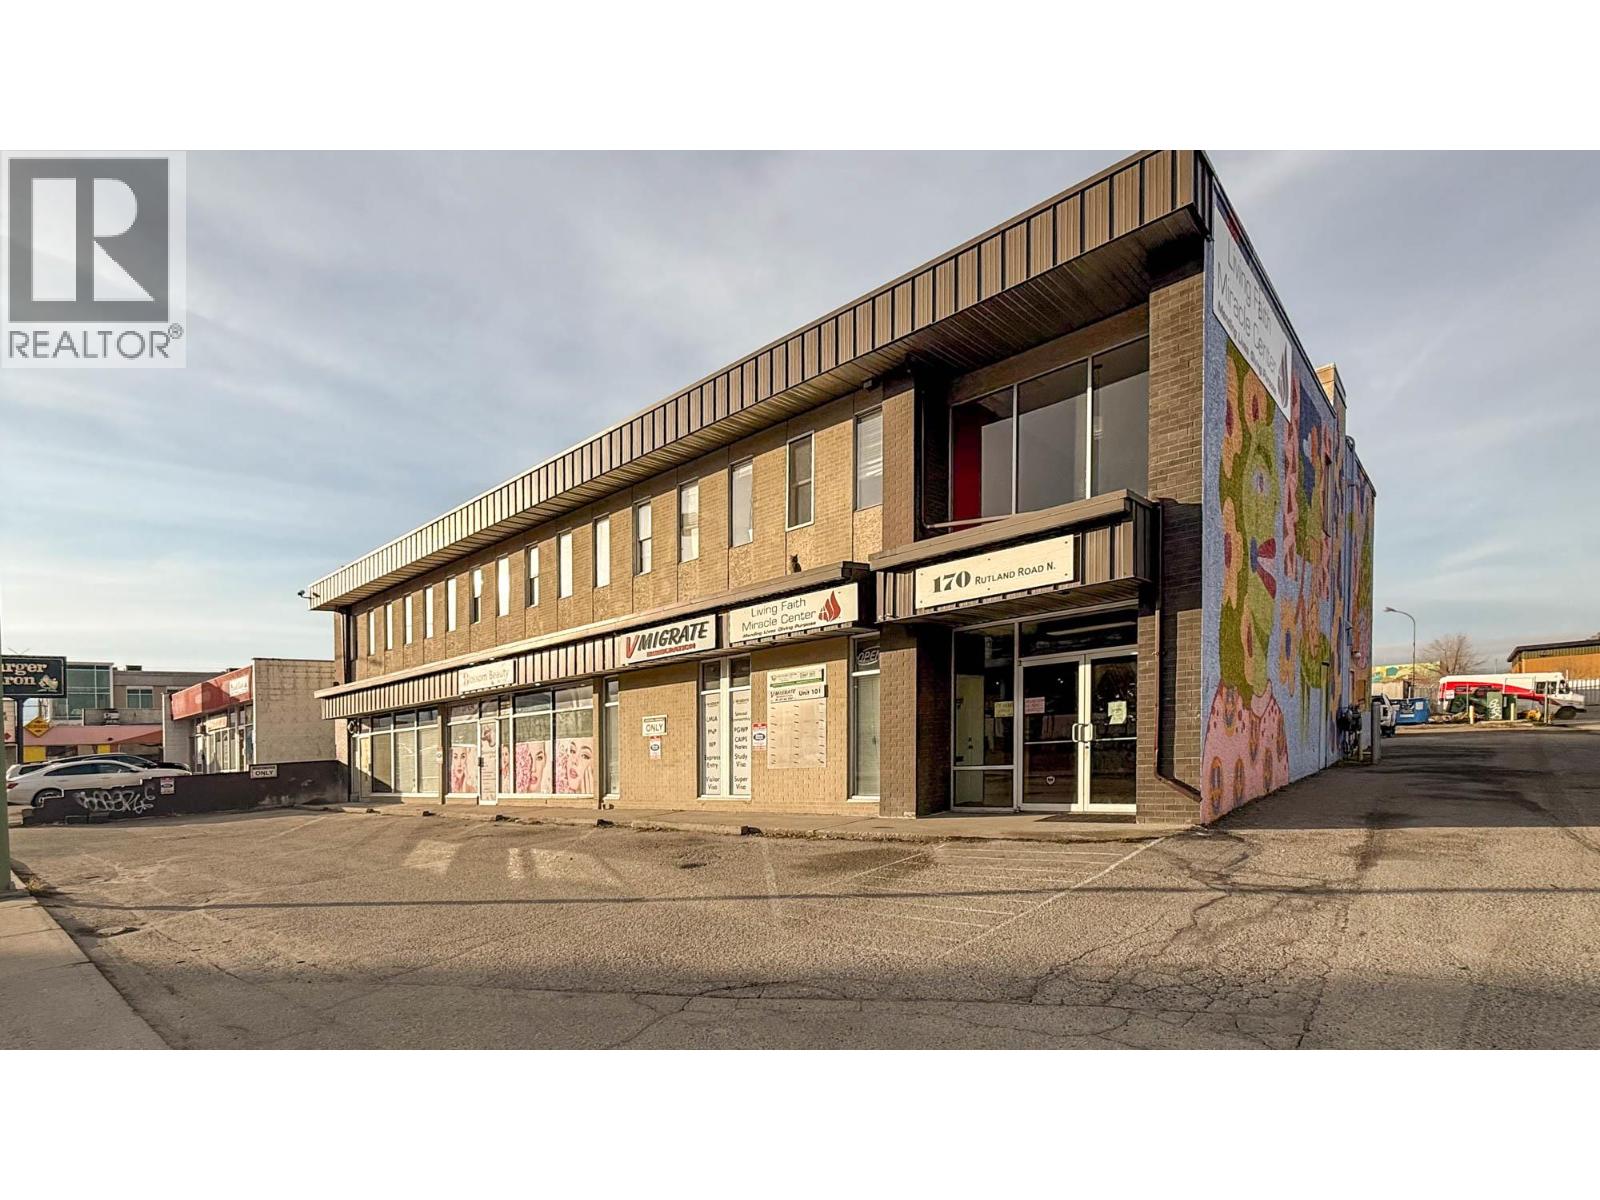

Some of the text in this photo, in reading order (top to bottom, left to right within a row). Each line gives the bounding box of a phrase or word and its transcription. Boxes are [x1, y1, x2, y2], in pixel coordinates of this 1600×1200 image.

[1228, 239, 1251, 308] Living
[1217, 262, 1277, 373] Miracle Center
[933, 561, 1056, 593] 170 RUTLAND ROAD N.
[741, 610, 816, 632] Miracle Center
[751, 598, 806, 618] Living Faith
[626, 621, 709, 658] VMIGRATE
[645, 723, 663, 732] ONLY
